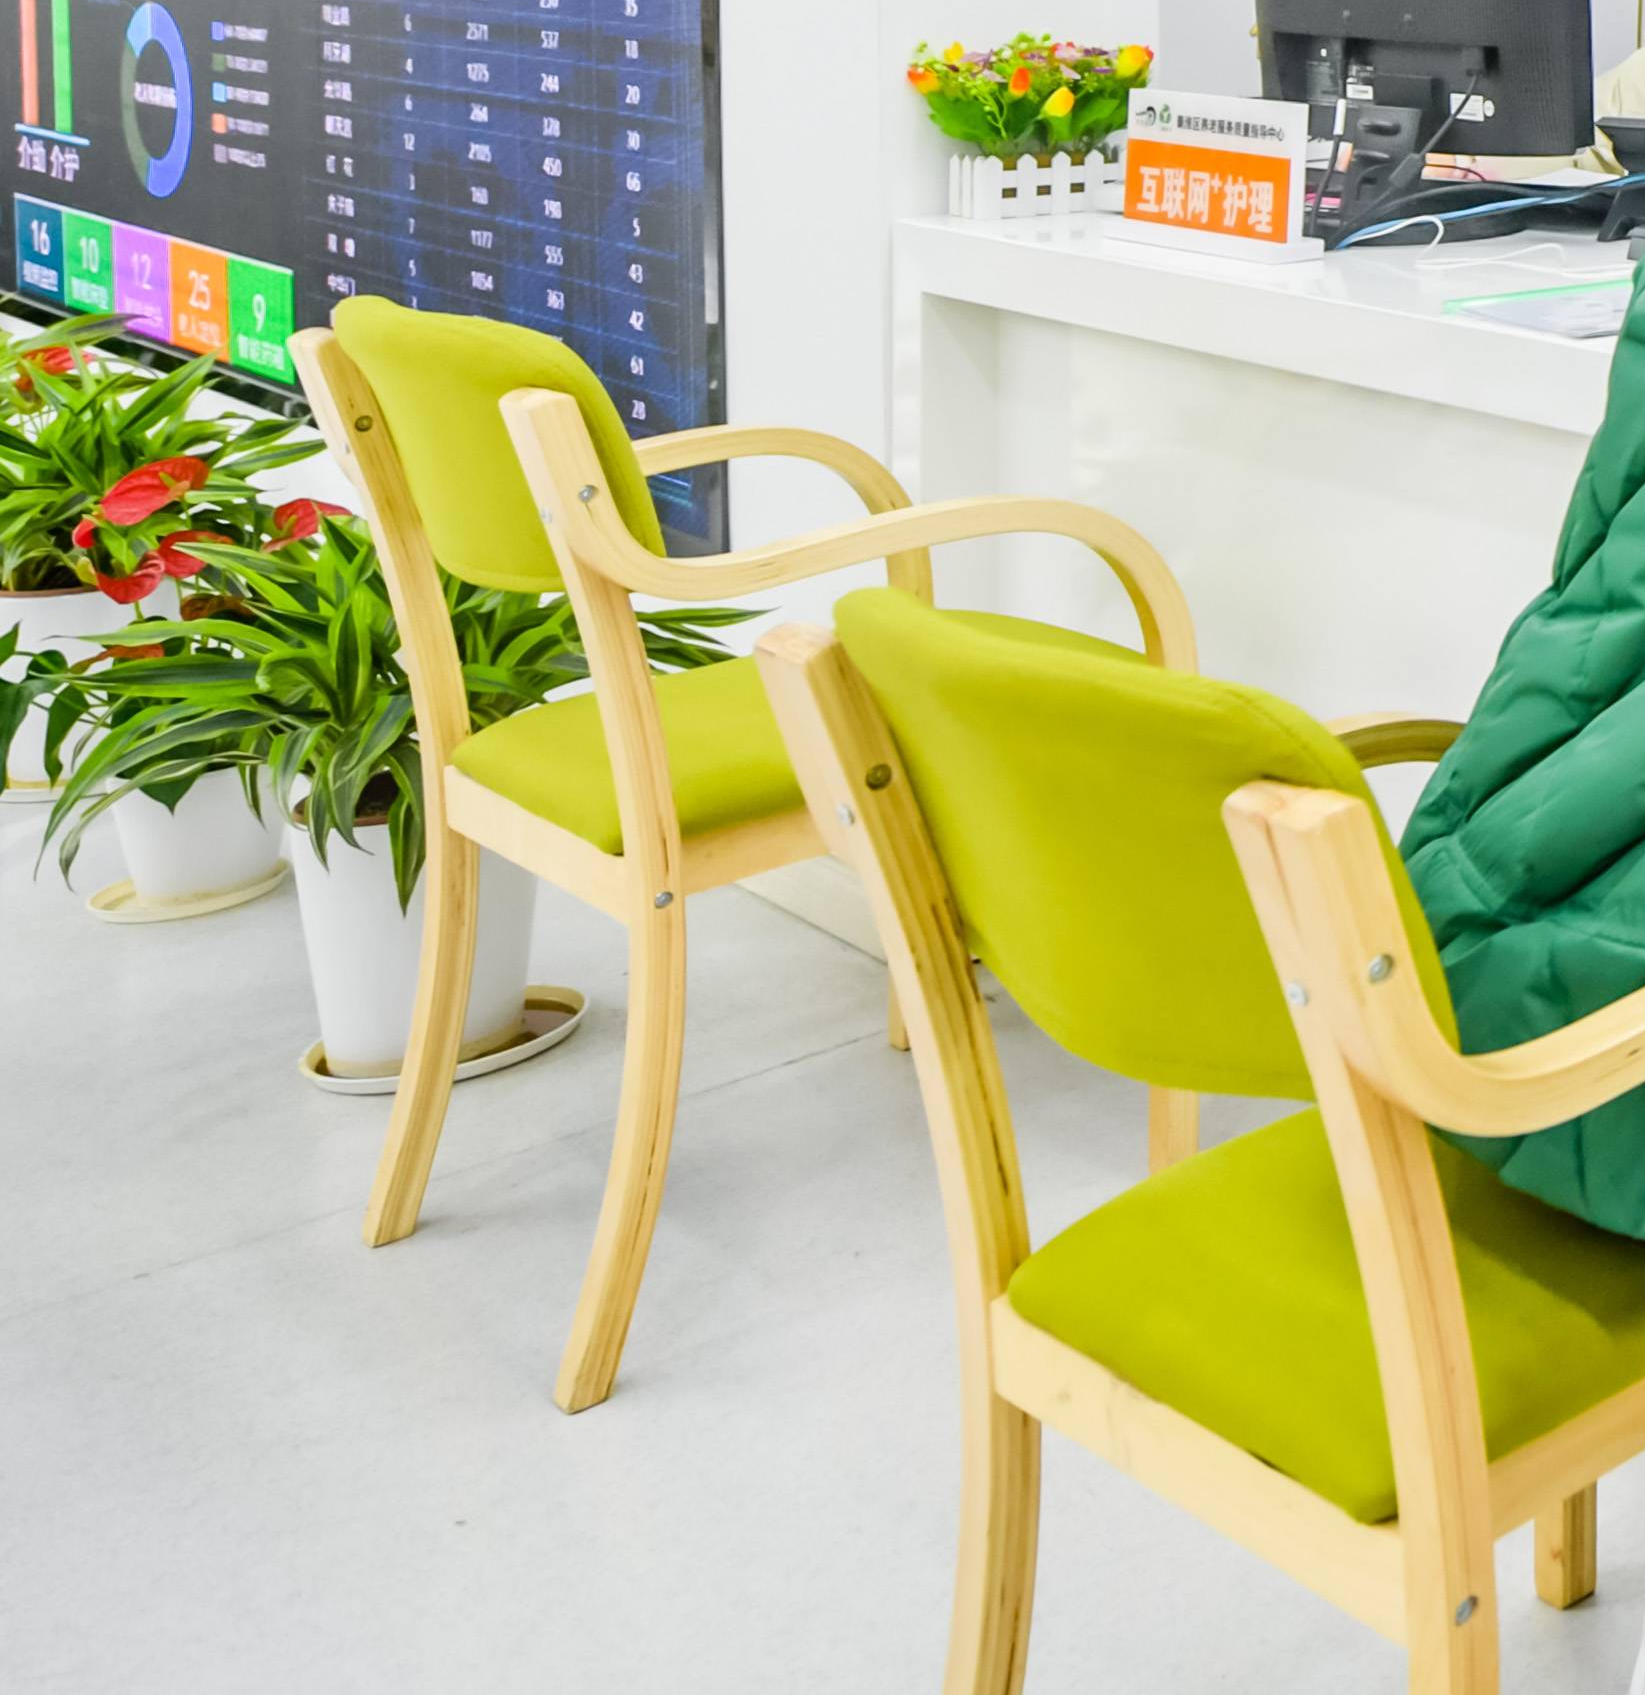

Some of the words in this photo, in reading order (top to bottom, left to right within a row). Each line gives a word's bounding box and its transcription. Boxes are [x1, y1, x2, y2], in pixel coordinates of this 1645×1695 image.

[625, 84, 641, 105] 20
[403, 133, 416, 151] 12
[626, 171, 642, 192] 66
[30, 219, 51, 255] 16
[632, 217, 641, 237] 5
[79, 236, 99, 273] 10
[131, 252, 152, 290] 12
[408, 259, 417, 277] 5
[628, 263, 644, 284] 43
[188, 270, 211, 311] 25
[252, 293, 267, 332] 9
[628, 310, 644, 331] 42
[630, 355, 644, 376] 61
